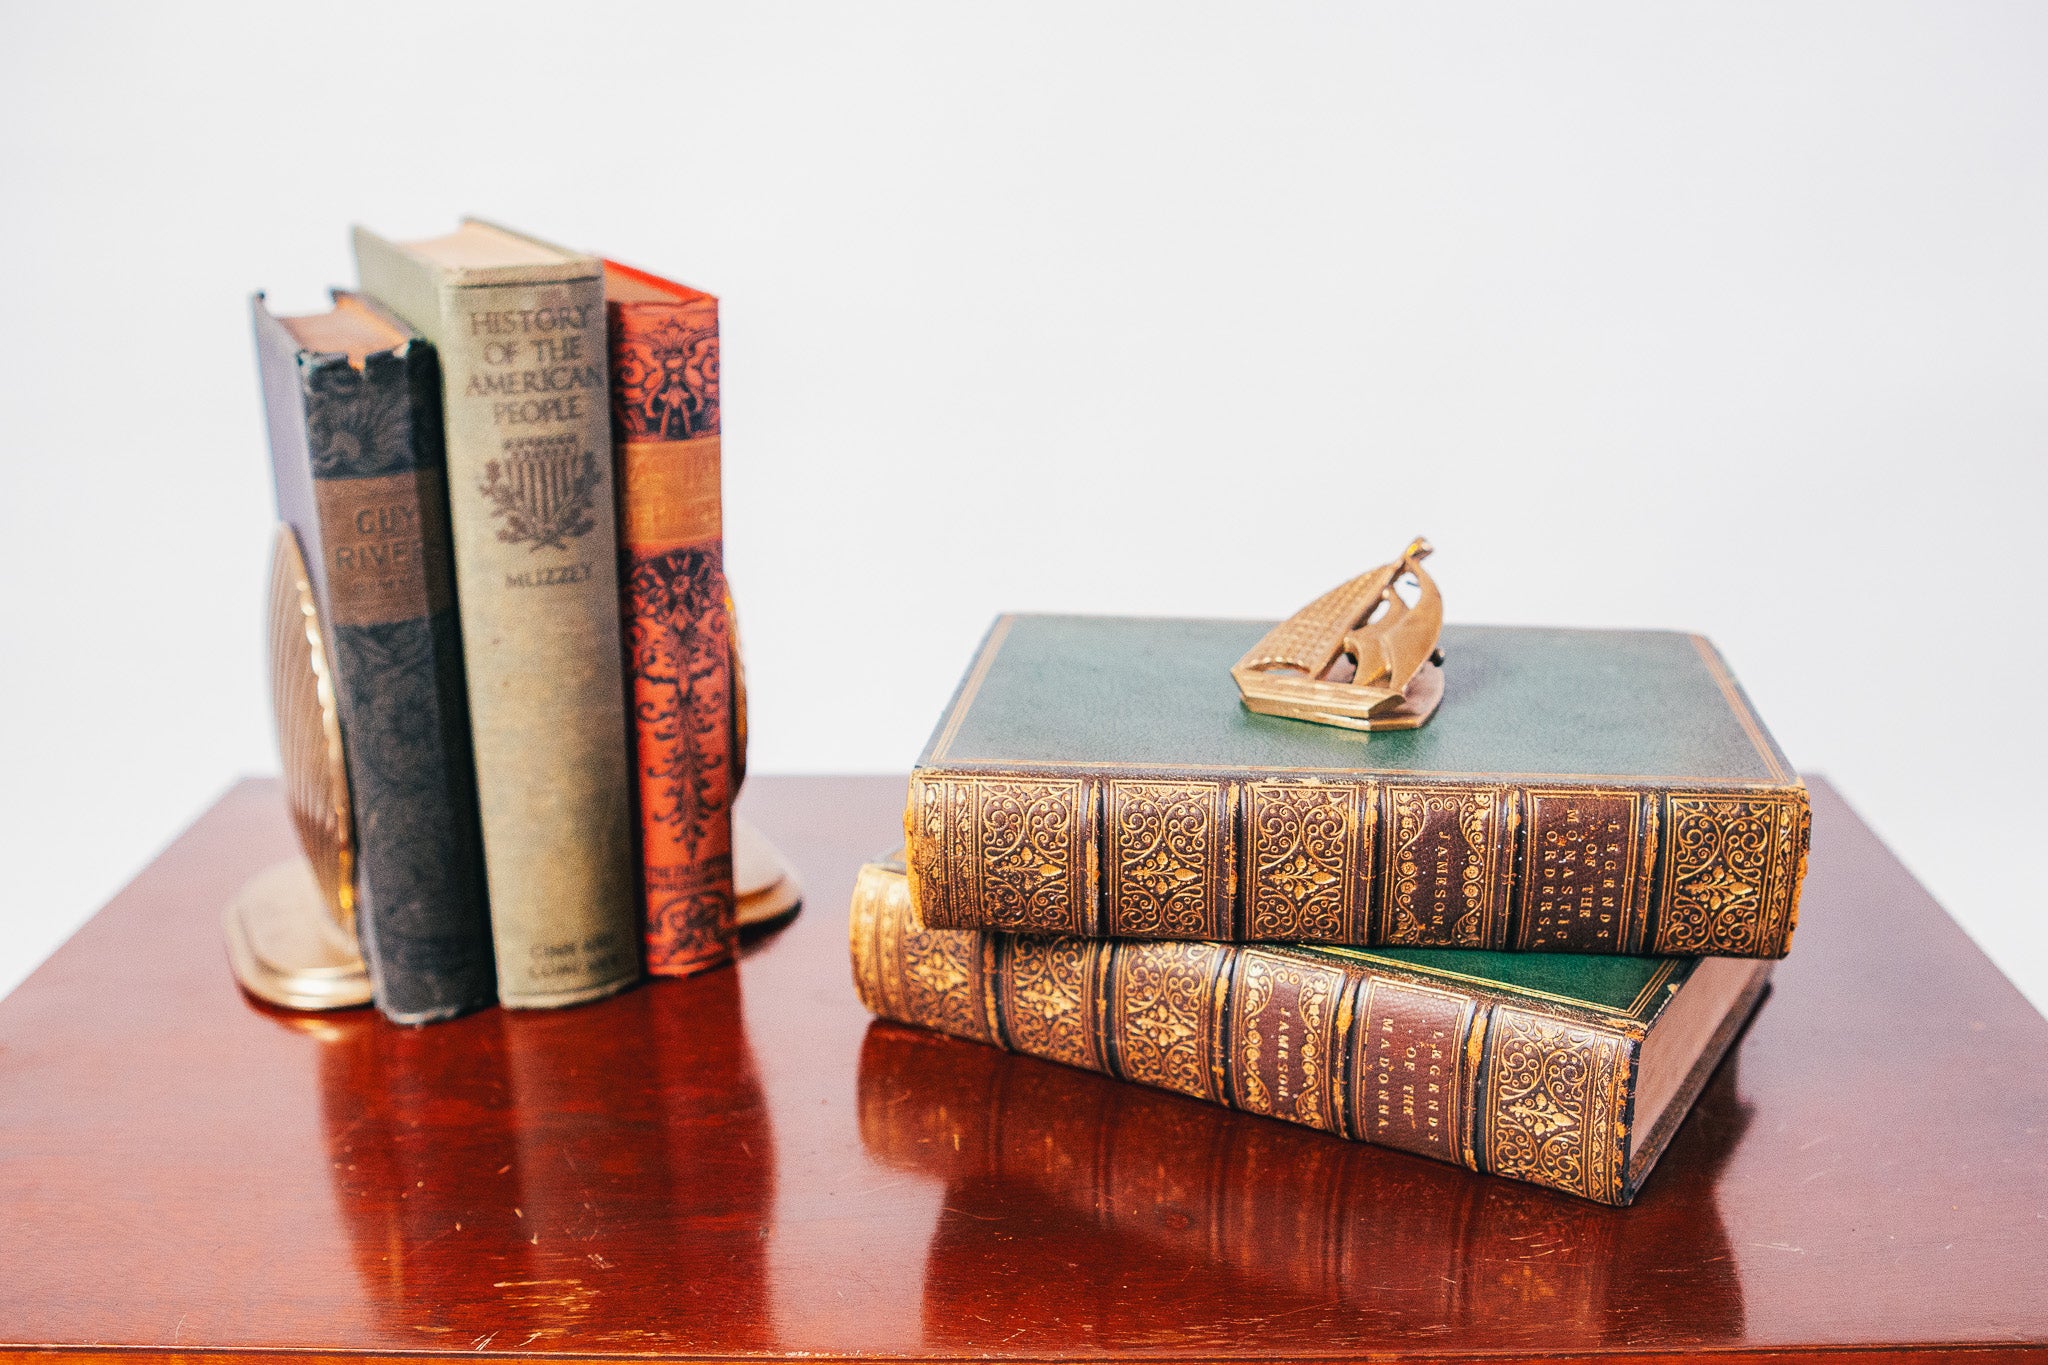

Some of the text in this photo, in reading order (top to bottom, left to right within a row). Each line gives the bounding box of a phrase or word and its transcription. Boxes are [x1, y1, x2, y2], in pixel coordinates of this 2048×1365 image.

[470, 304, 593, 336] HISTORY
[484, 335, 581, 366] OF THE
[464, 366, 602, 397] AMERICAN
[494, 395, 582, 425] PEOPLE
[356, 504, 414, 535] GUY
[504, 561, 593, 588] MUZZEY
[1557, 809, 1579, 939] MONASTIC
[1580, 843, 1598, 918] OF THE
[1597, 823, 1620, 938] LEGENDS
[1403, 1047, 1416, 1120] OF THE
[1428, 1030, 1444, 1142] LEGENDS
